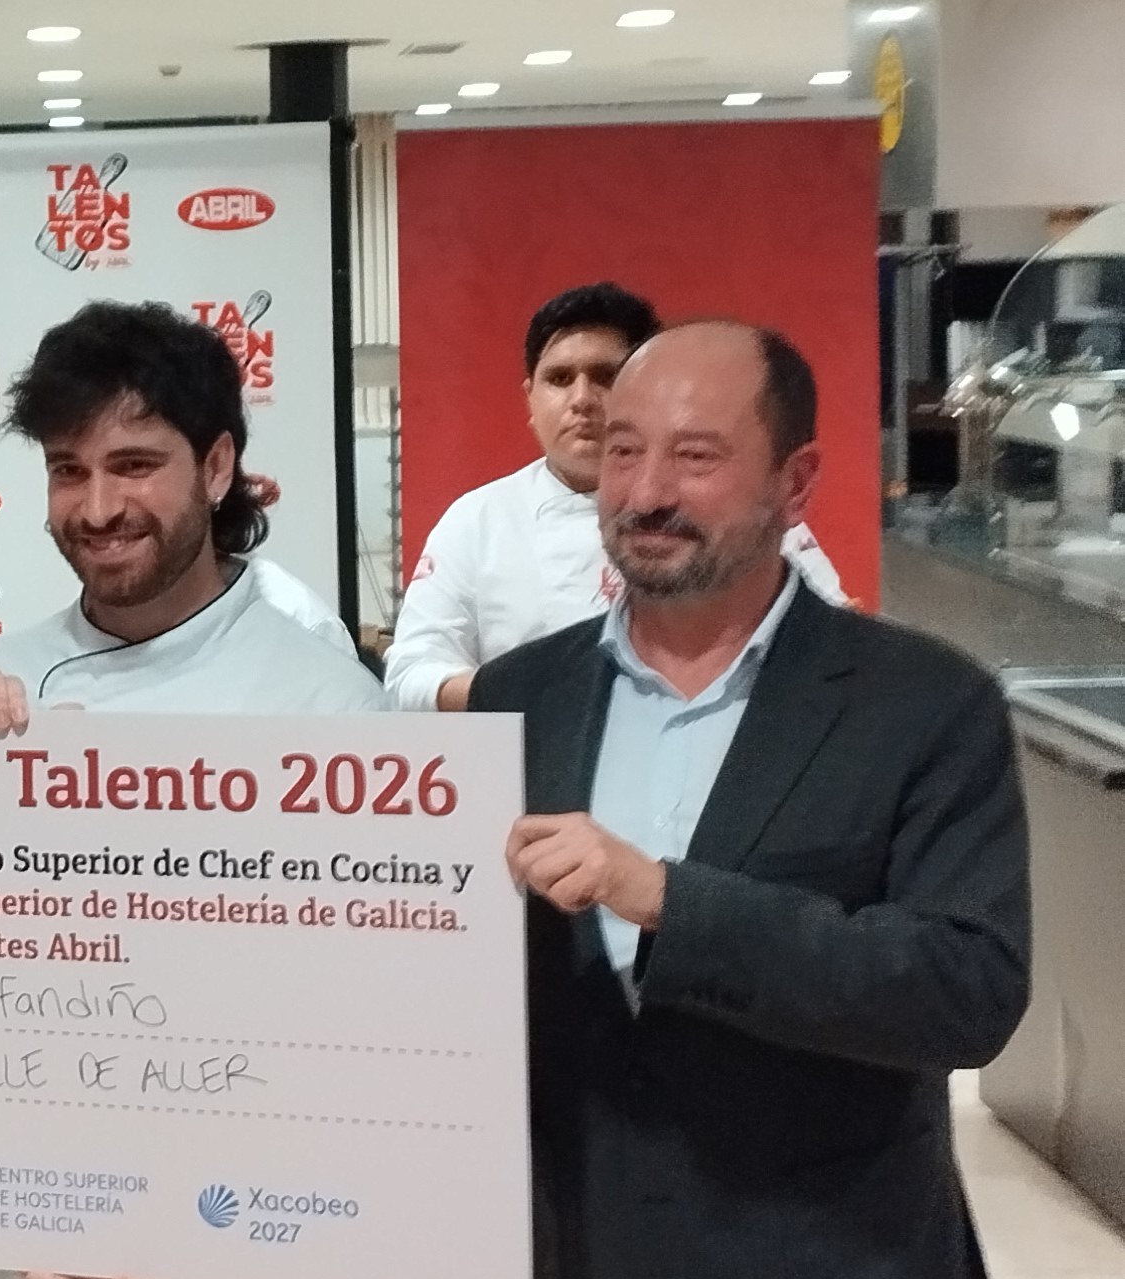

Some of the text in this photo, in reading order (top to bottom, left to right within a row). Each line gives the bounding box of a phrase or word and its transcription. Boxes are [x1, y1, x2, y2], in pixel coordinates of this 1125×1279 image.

[47, 163, 101, 191] TA
[48, 192, 130, 221] LEN
[188, 194, 266, 223] ABRIL
[49, 222, 130, 252] TOS
[191, 301, 245, 328] TA
[6, 748, 259, 812] Talento
[280, 752, 459, 816] 2026
[13, 844, 145, 880] Superior
[153, 848, 190, 877] de
[199, 849, 275, 879] Chef
[281, 858, 322, 881] en
[330, 853, 443, 885] Cocina
[452, 863, 474, 893] y
[81, 890, 118, 918] de
[126, 892, 290, 926] Hostelería
[298, 897, 336, 927] de
[345, 898, 468, 932] Galicia.
[47, 933, 131, 963] Abril.
[0, 975, 167, 1027] Fandiño
[79, 1051, 121, 1090] DE
[141, 1053, 269, 1093] ALLER
[63, 1171, 149, 1193] SUPERIOR
[15, 1191, 124, 1214] HOSTELERÍA
[248, 1187, 360, 1219] Xacobeo
[14, 1214, 86, 1234] GALICIA
[249, 1222, 302, 1243] 2027
